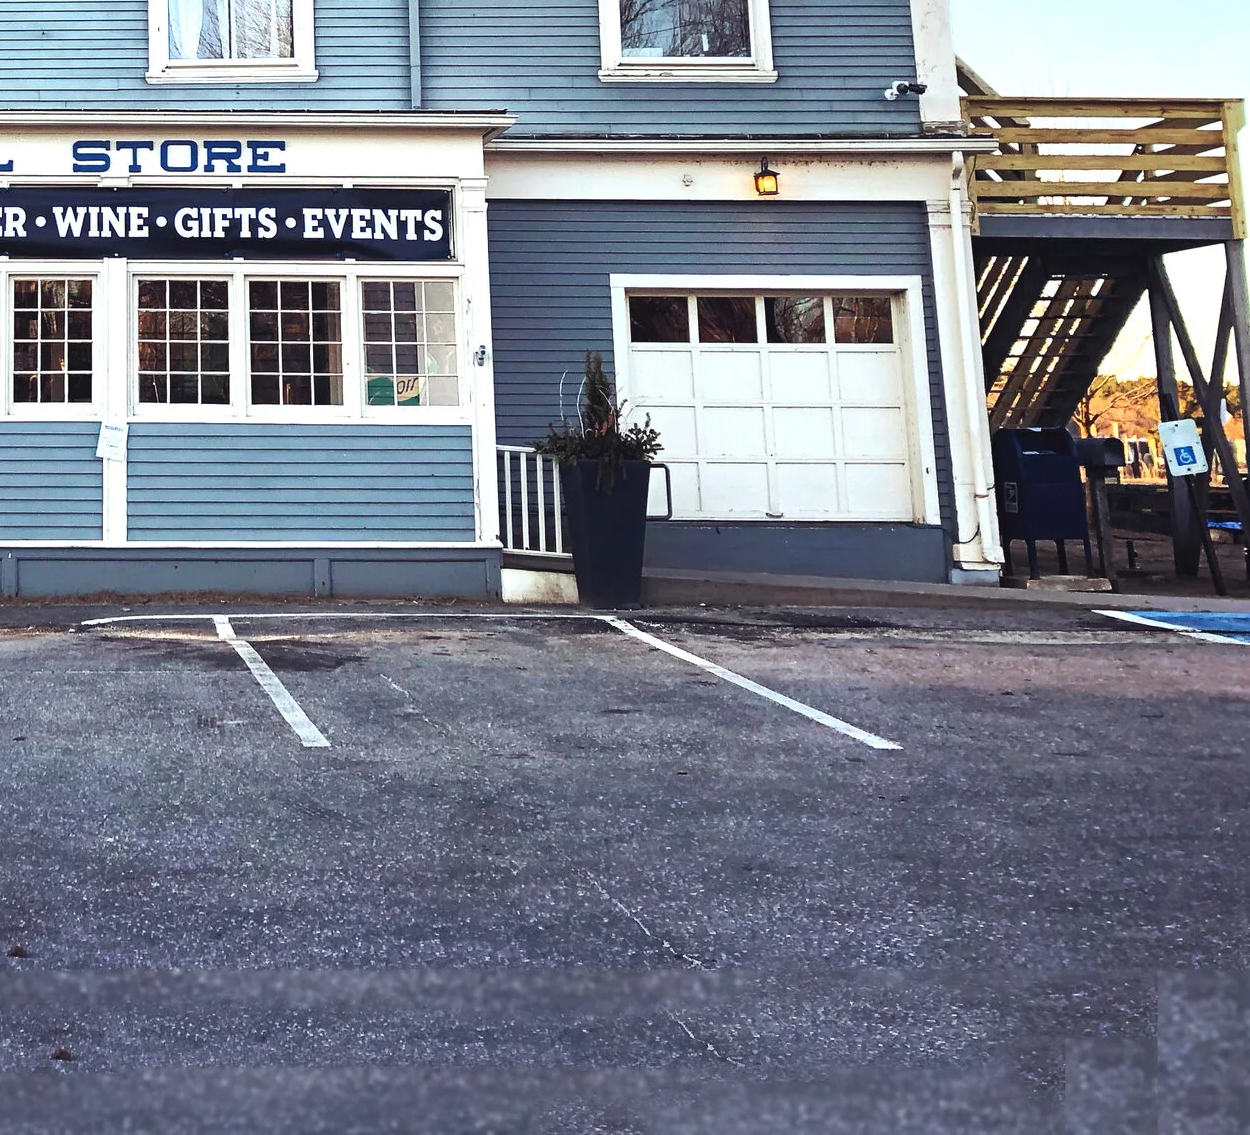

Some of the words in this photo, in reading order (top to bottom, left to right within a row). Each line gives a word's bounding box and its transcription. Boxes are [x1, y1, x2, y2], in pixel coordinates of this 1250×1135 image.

[73, 140, 285, 173] STORE
[53, 206, 149, 238] WINE
[174, 207, 277, 239] GIFTS
[302, 208, 443, 241] EVENTS
